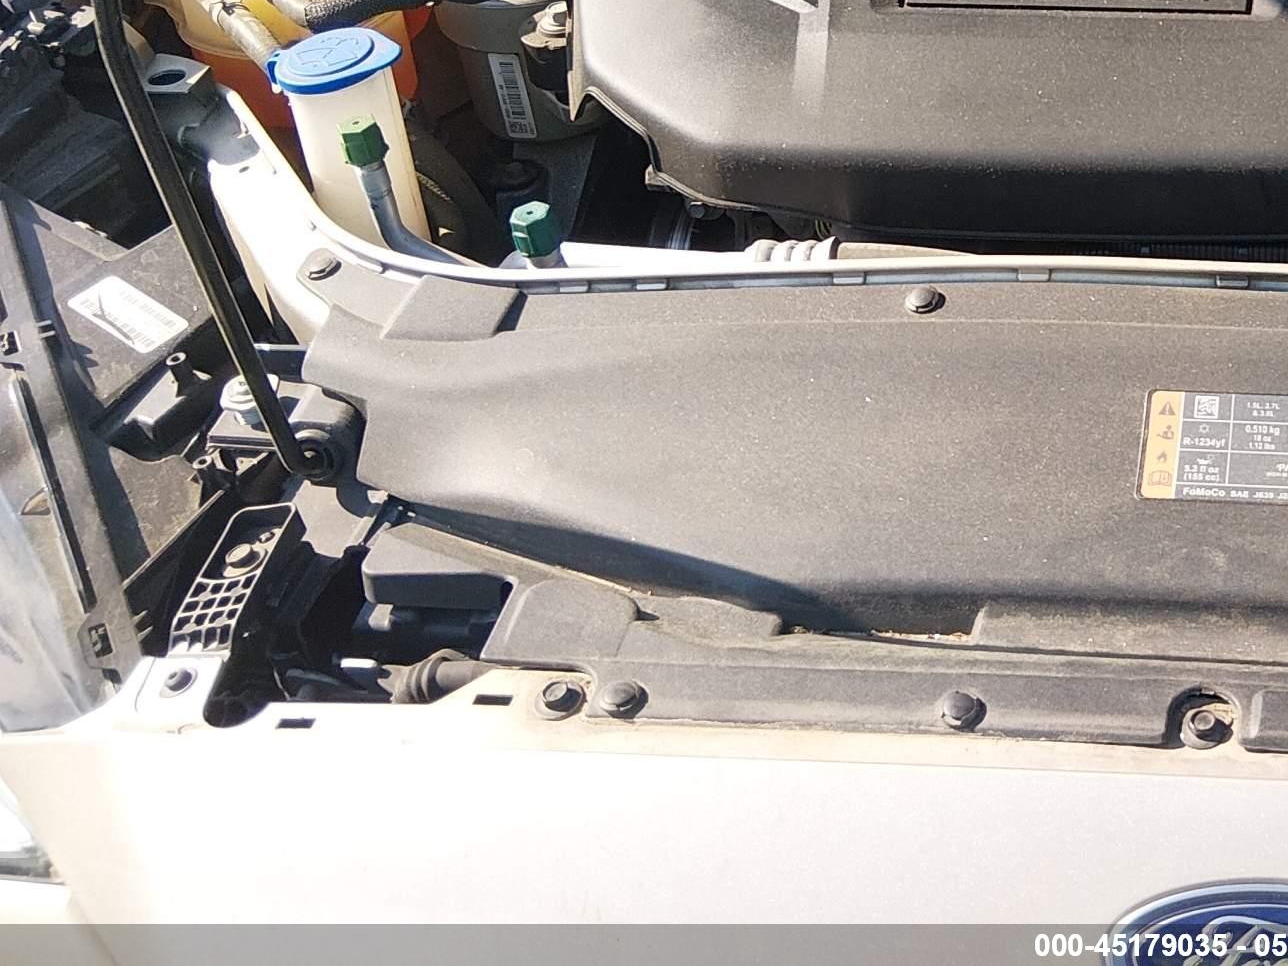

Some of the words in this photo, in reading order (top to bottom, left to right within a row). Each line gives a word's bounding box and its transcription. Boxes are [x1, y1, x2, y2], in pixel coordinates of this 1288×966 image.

[1268, 425, 1280, 436] kg
[1183, 436, 1226, 449] R-1234yf
[1183, 487, 1226, 497] FoMoCo
